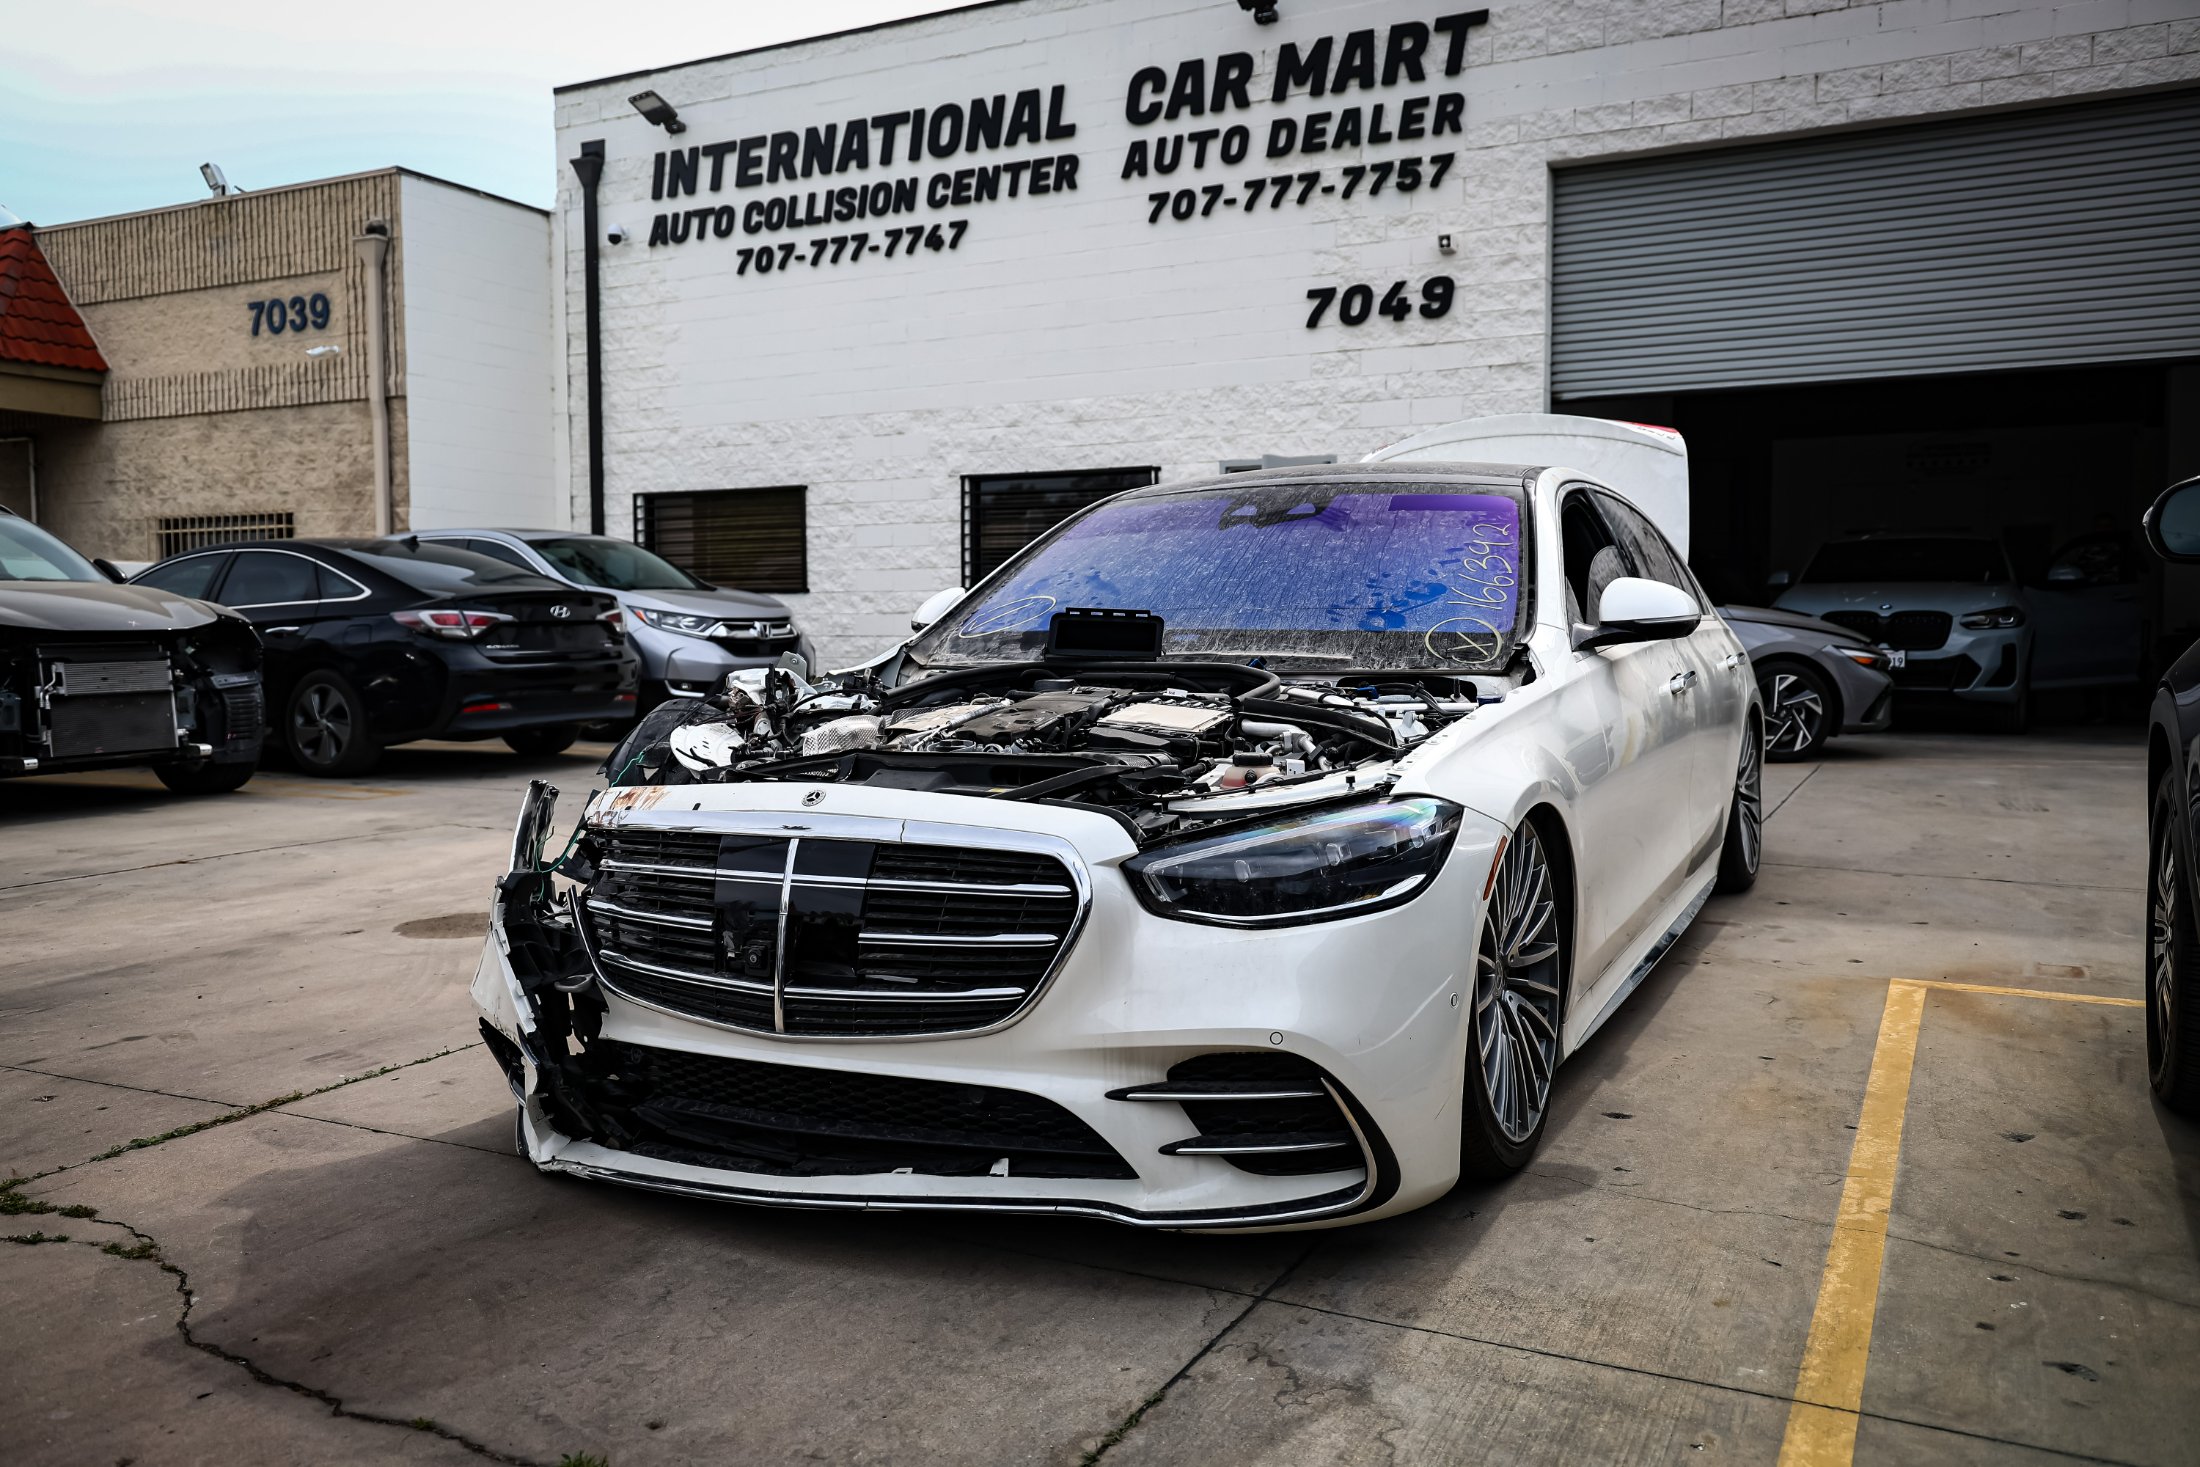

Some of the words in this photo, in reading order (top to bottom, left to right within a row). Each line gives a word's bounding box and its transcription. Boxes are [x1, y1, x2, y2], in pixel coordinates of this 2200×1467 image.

[1126, 52, 1254, 126] CAR
[1271, 9, 1489, 104] MART
[652, 85, 1076, 200] INTERNATIONAL
[1121, 125, 1249, 180] AUTO
[1266, 93, 1465, 159] DEALER
[649, 206, 735, 248] AUTO
[743, 178, 918, 234] COLLISION
[927, 154, 1079, 209] CENTER
[1149, 153, 1455, 224] 707-777-7757
[737, 220, 968, 275] 707-777-7747
[247, 293, 331, 337] 7039
[1306, 276, 1455, 329] 7049
